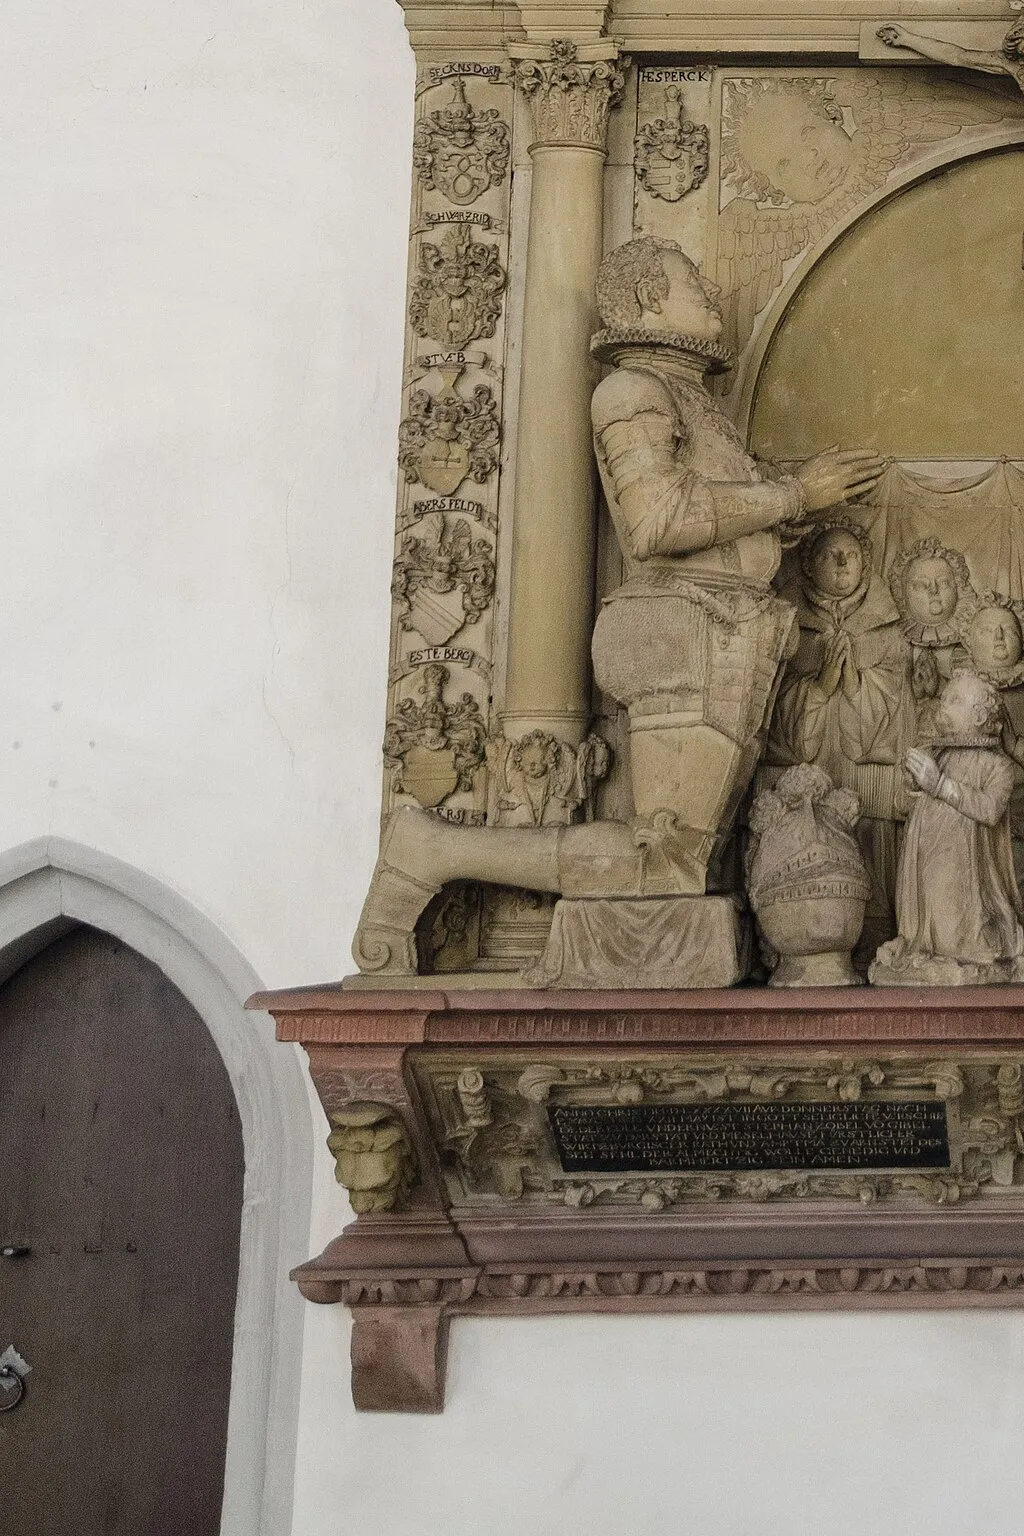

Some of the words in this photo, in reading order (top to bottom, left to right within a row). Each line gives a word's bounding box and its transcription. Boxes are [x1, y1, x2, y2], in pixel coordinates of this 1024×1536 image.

[780, 1105, 880, 1113] DONNERSTAG
[886, 1104, 927, 1112] NACH
[819, 1146, 890, 1156] GENEDIG
[893, 1146, 922, 1155] VND
[810, 1153, 860, 1164] AMEN
